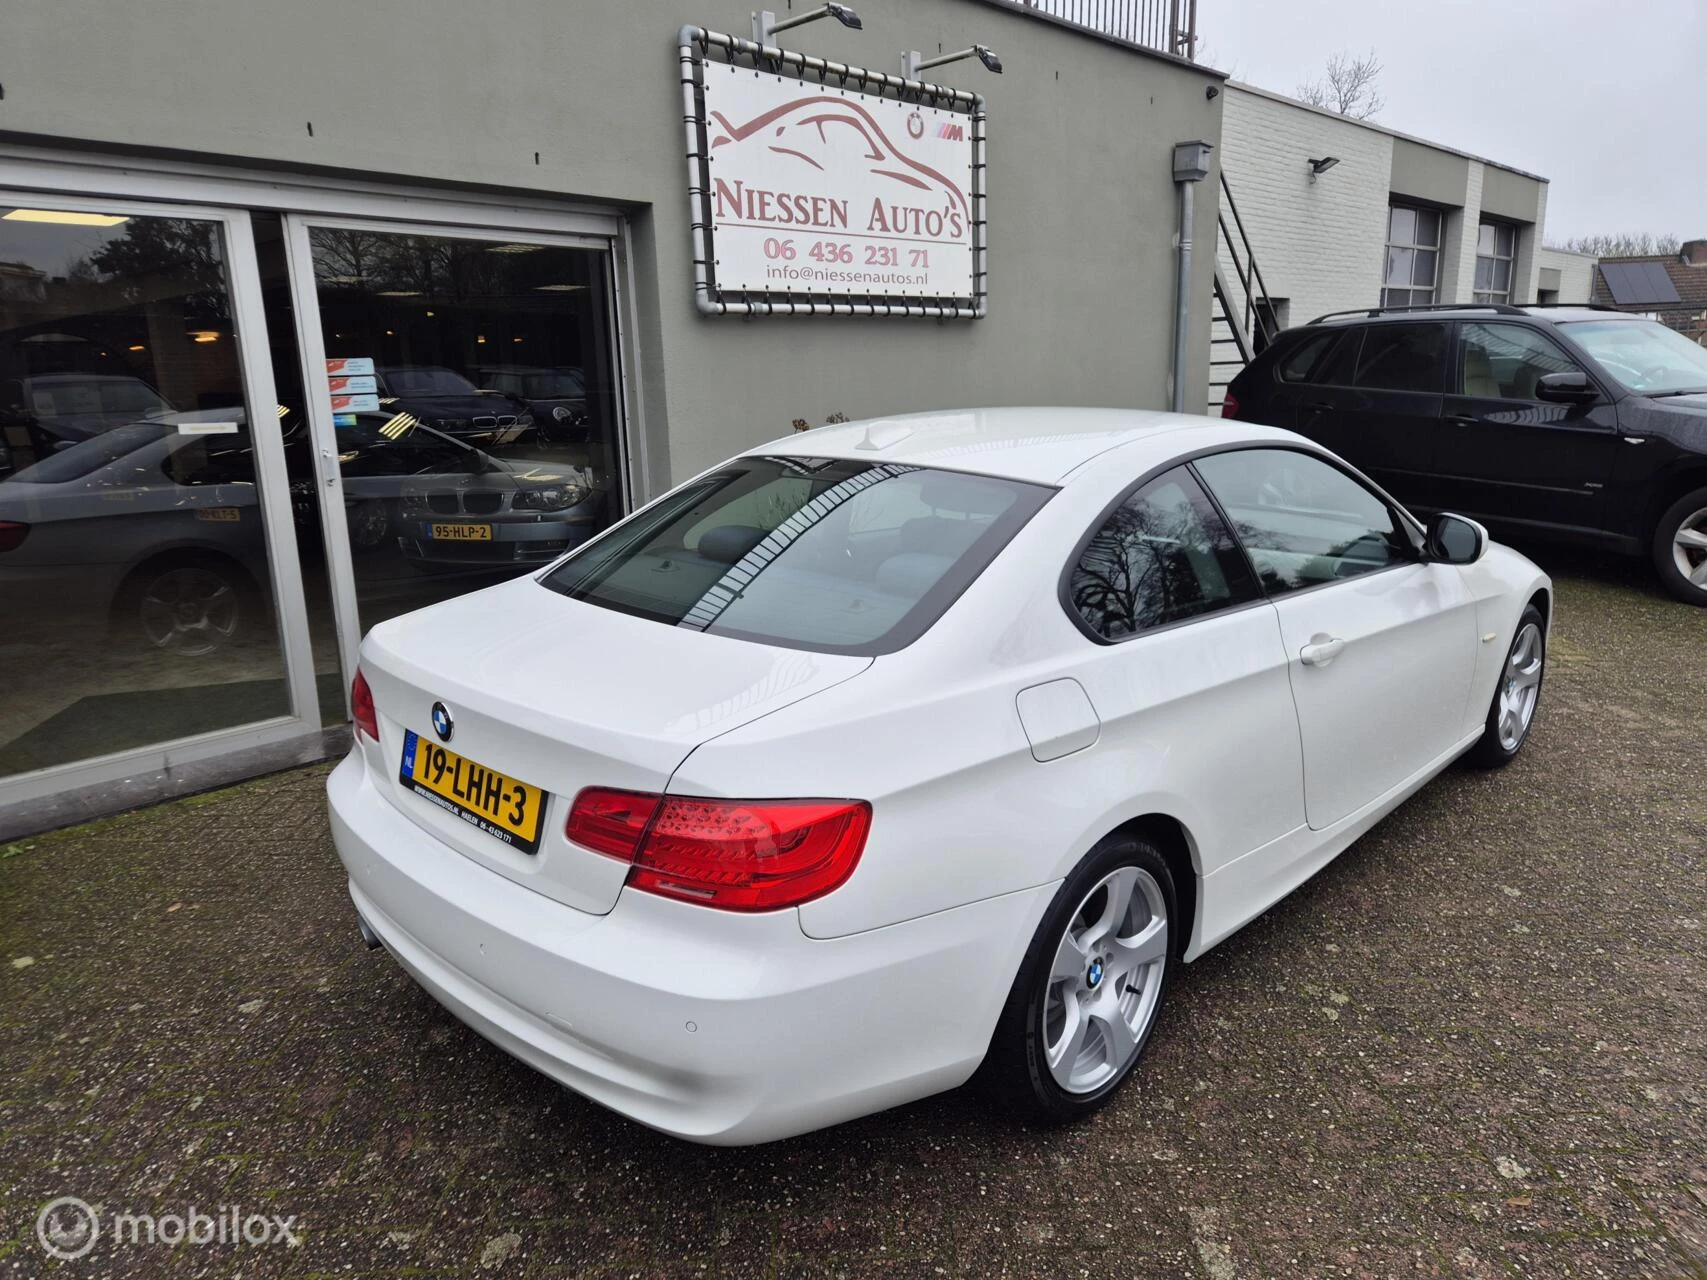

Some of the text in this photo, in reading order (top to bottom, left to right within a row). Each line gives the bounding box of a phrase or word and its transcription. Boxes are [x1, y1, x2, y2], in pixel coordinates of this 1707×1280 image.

[713, 177, 963, 239] NIESSEN AUTO'S
[763, 237, 930, 269] 06 436 231 71
[766, 265, 929, 286] info@niessenautos.nl
[435, 525, 488, 539] 95-HLP-2
[404, 755, 414, 769] NL
[423, 743, 528, 828] 19-LHH-3
